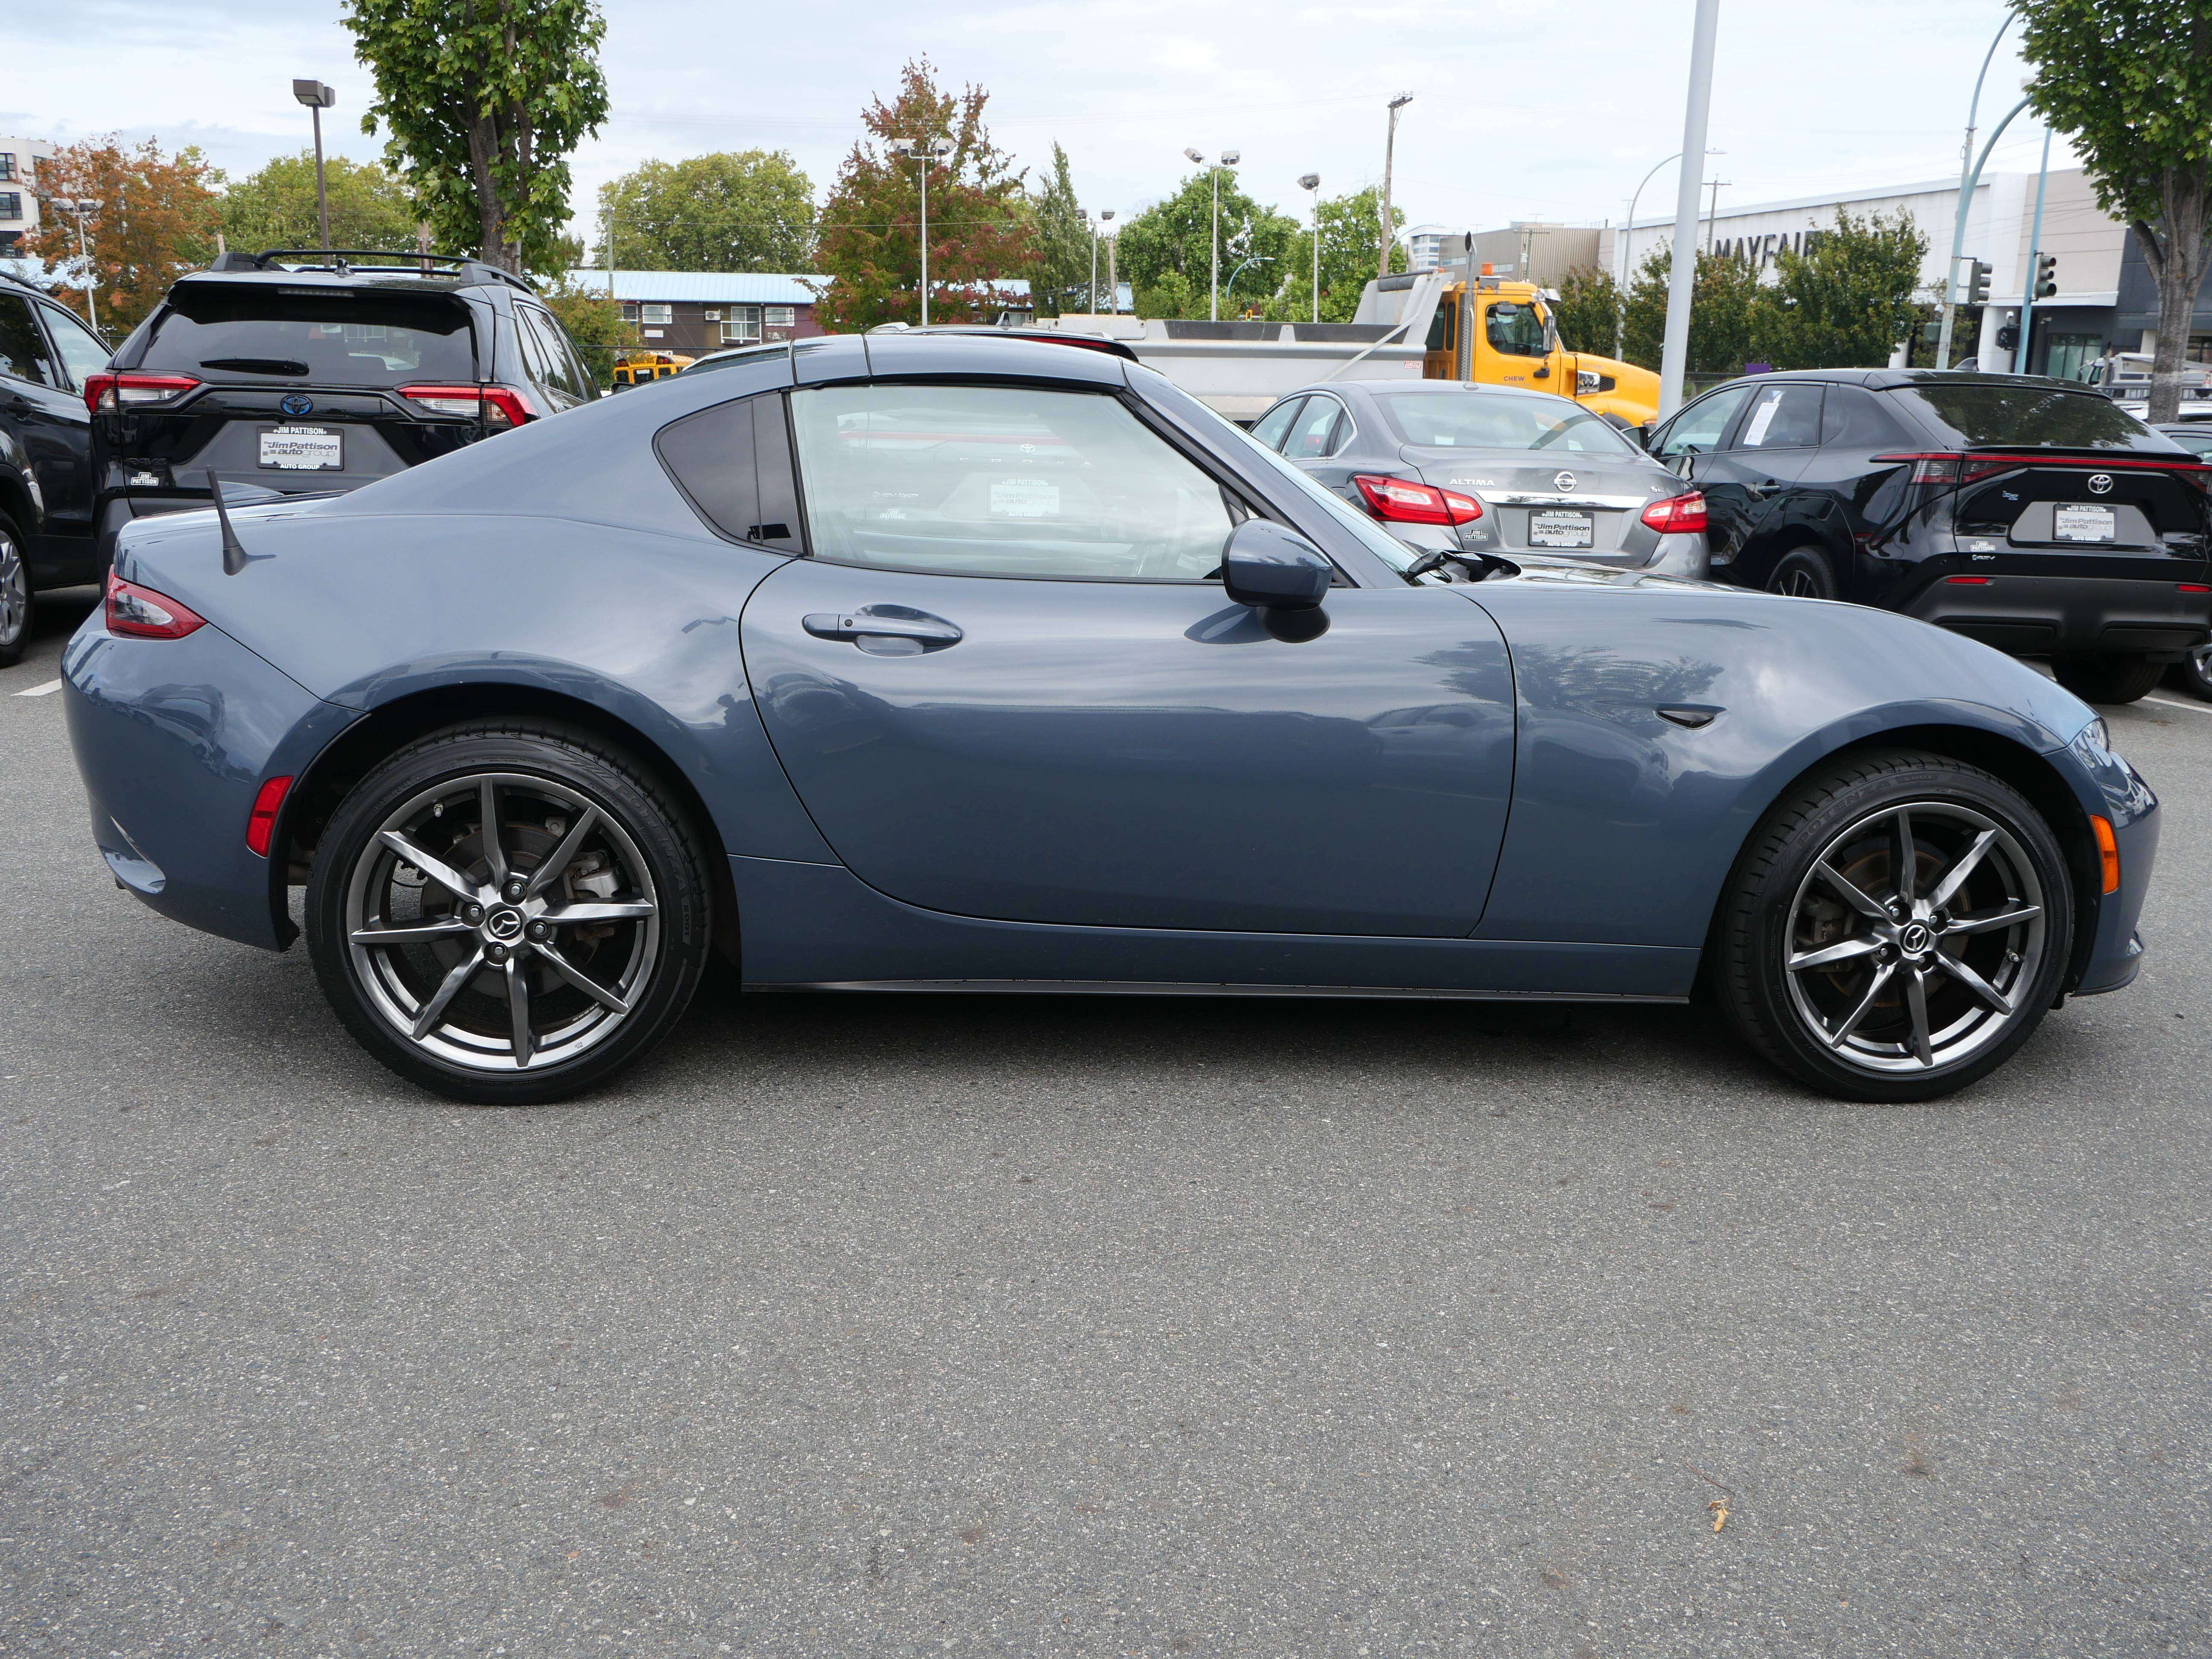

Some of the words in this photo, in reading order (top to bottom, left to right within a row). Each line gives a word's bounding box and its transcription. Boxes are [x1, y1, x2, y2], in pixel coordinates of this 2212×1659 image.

[289, 442, 338, 450] Pattison
[615, 784, 687, 891] POTENZA
[1796, 780, 1891, 849] POTENZA
[1903, 774, 1932, 782] S001
